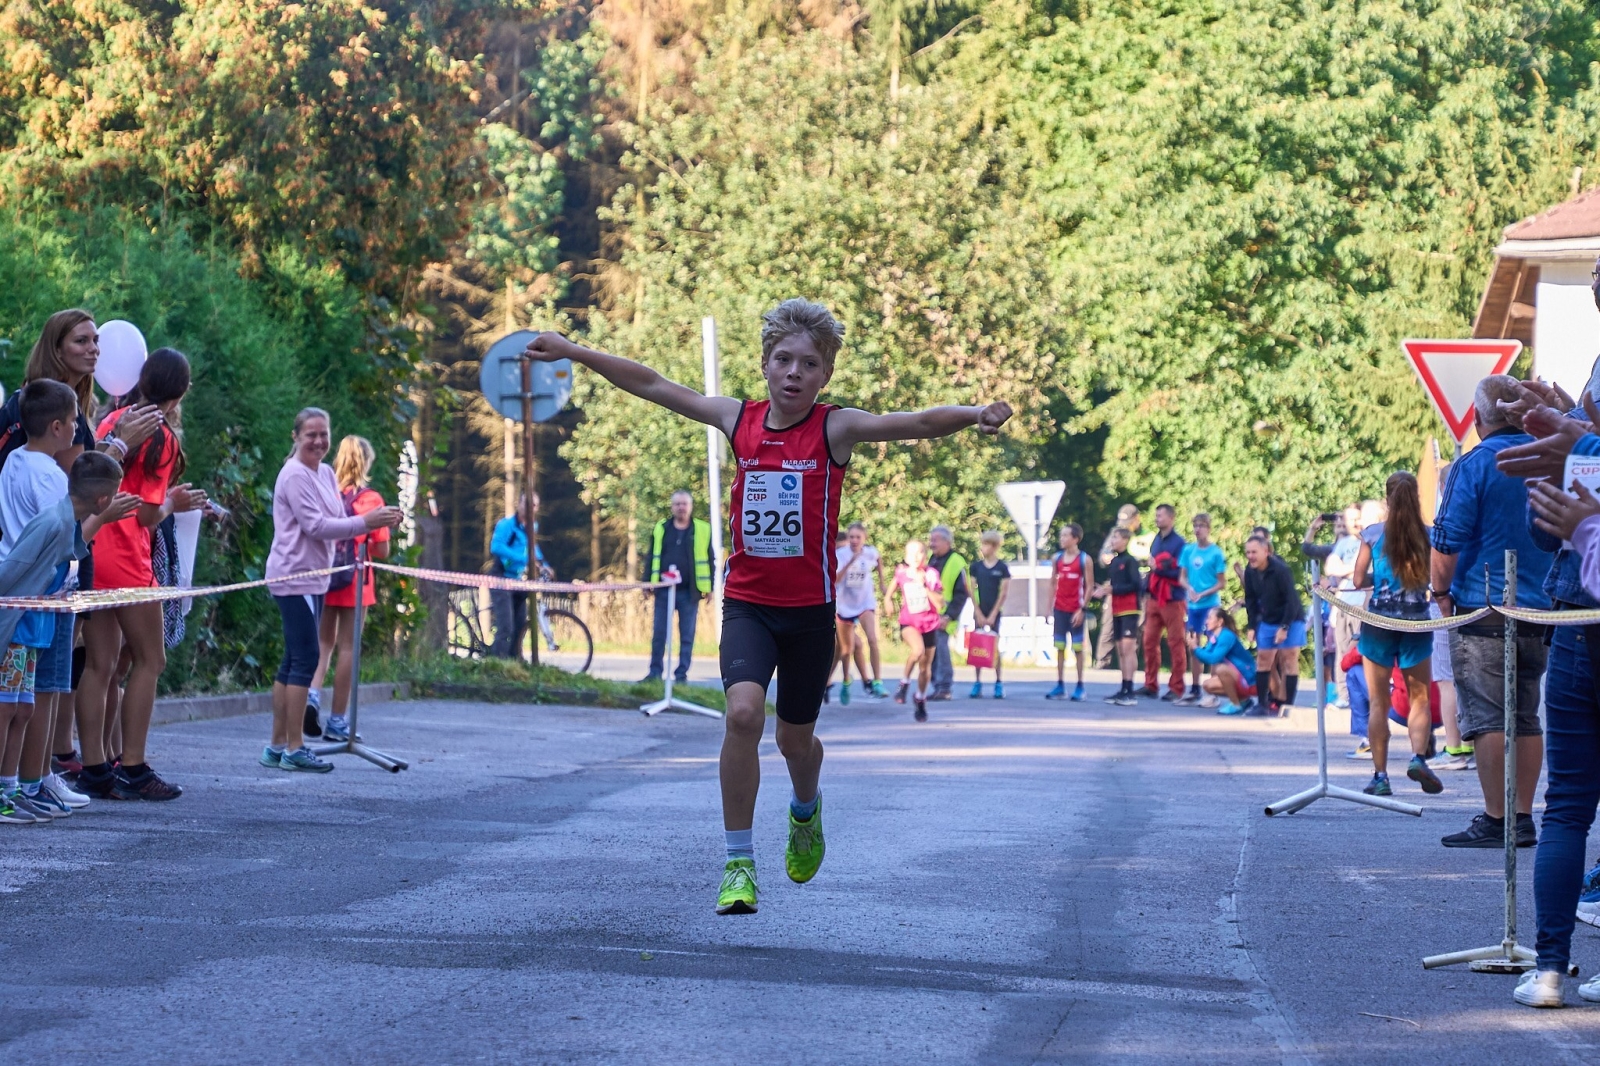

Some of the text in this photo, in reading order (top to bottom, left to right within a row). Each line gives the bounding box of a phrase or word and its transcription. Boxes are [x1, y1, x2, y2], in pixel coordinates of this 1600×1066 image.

[1571, 467, 1600, 475] CUP
[747, 493, 767, 502] CUP
[744, 510, 801, 536] 326
